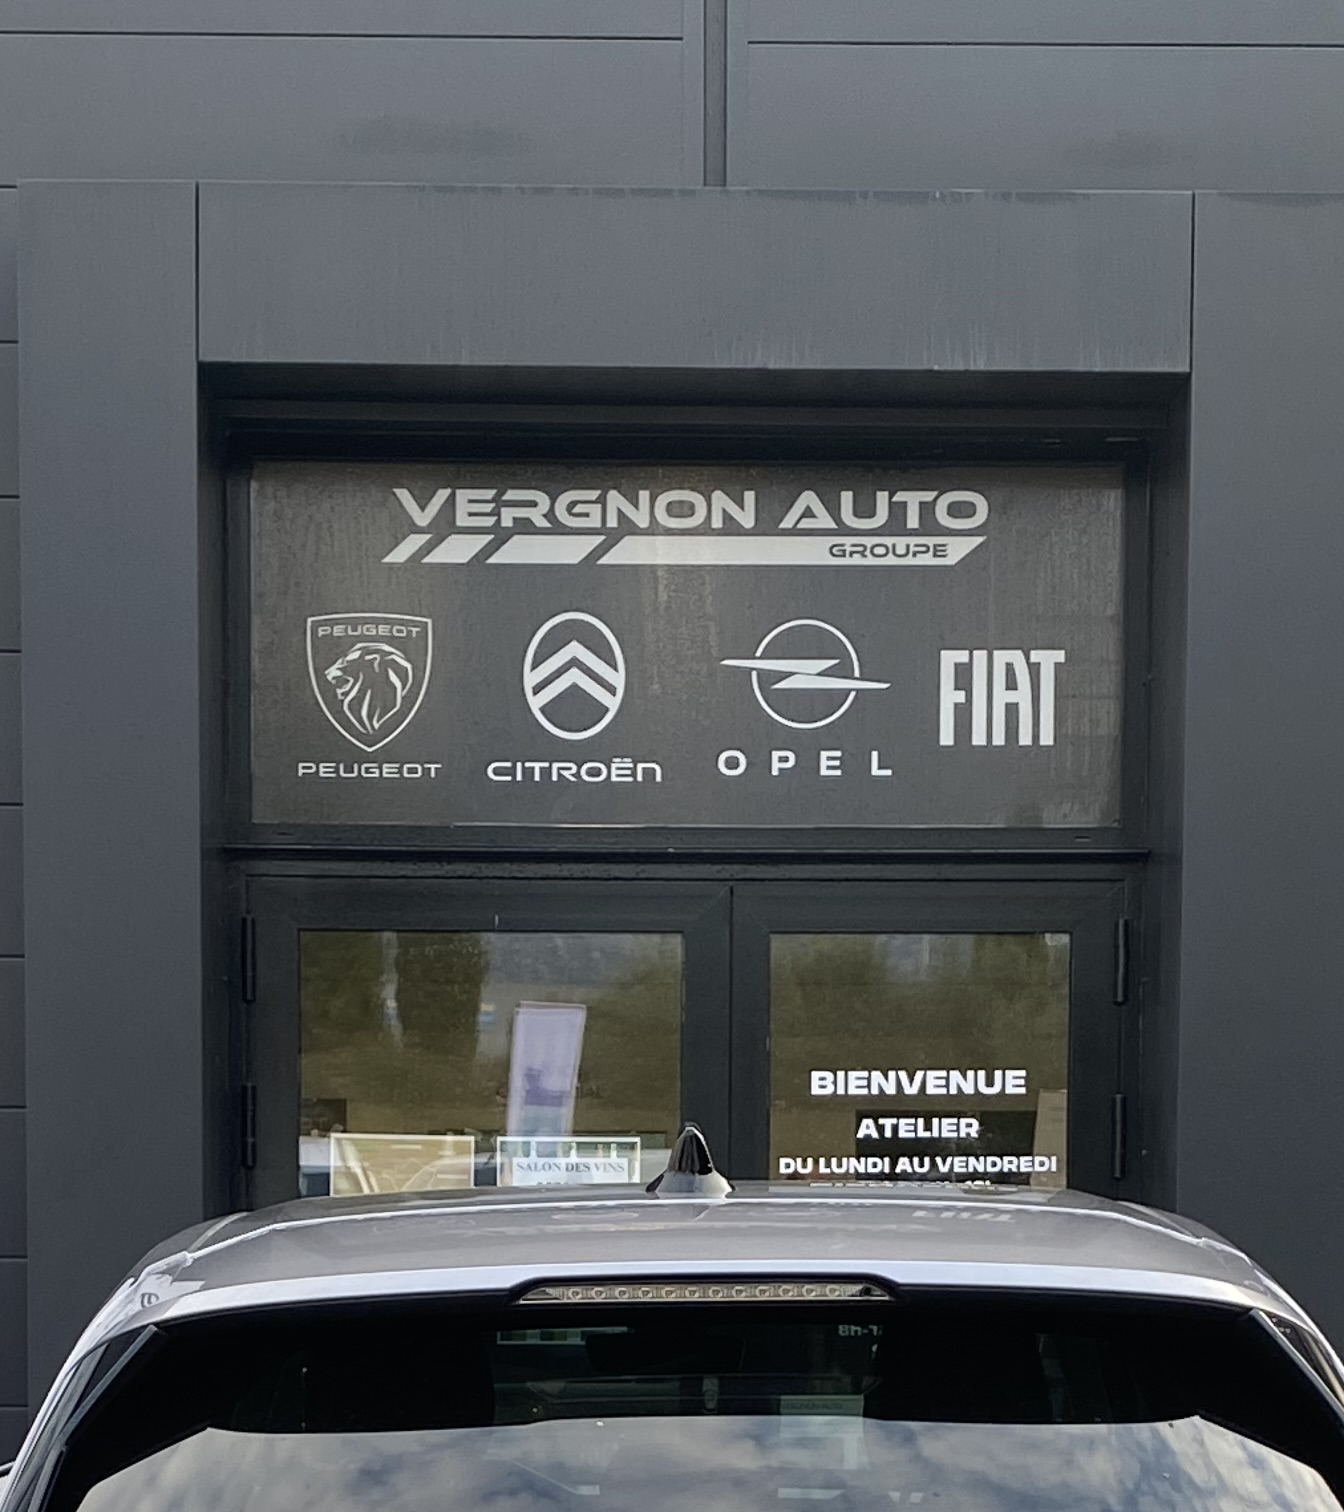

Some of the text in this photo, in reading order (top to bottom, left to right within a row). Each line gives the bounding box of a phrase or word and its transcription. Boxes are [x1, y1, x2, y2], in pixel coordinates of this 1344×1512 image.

[392, 487, 989, 530] VERGNON AUTO
[828, 542, 949, 559] GROUPE
[317, 624, 422, 638] PEUGEOT
[939, 649, 1066, 746] FIAT
[298, 762, 443, 779] PEUGEOT
[717, 749, 893, 776] OPEL
[810, 1069, 1027, 1096] BIENVENUE
[856, 1117, 980, 1140] ATELIER
[516, 1162, 625, 1172] SALON DES VINS
[779, 1155, 1058, 1174] DU LUNDI AU VENDREDI
